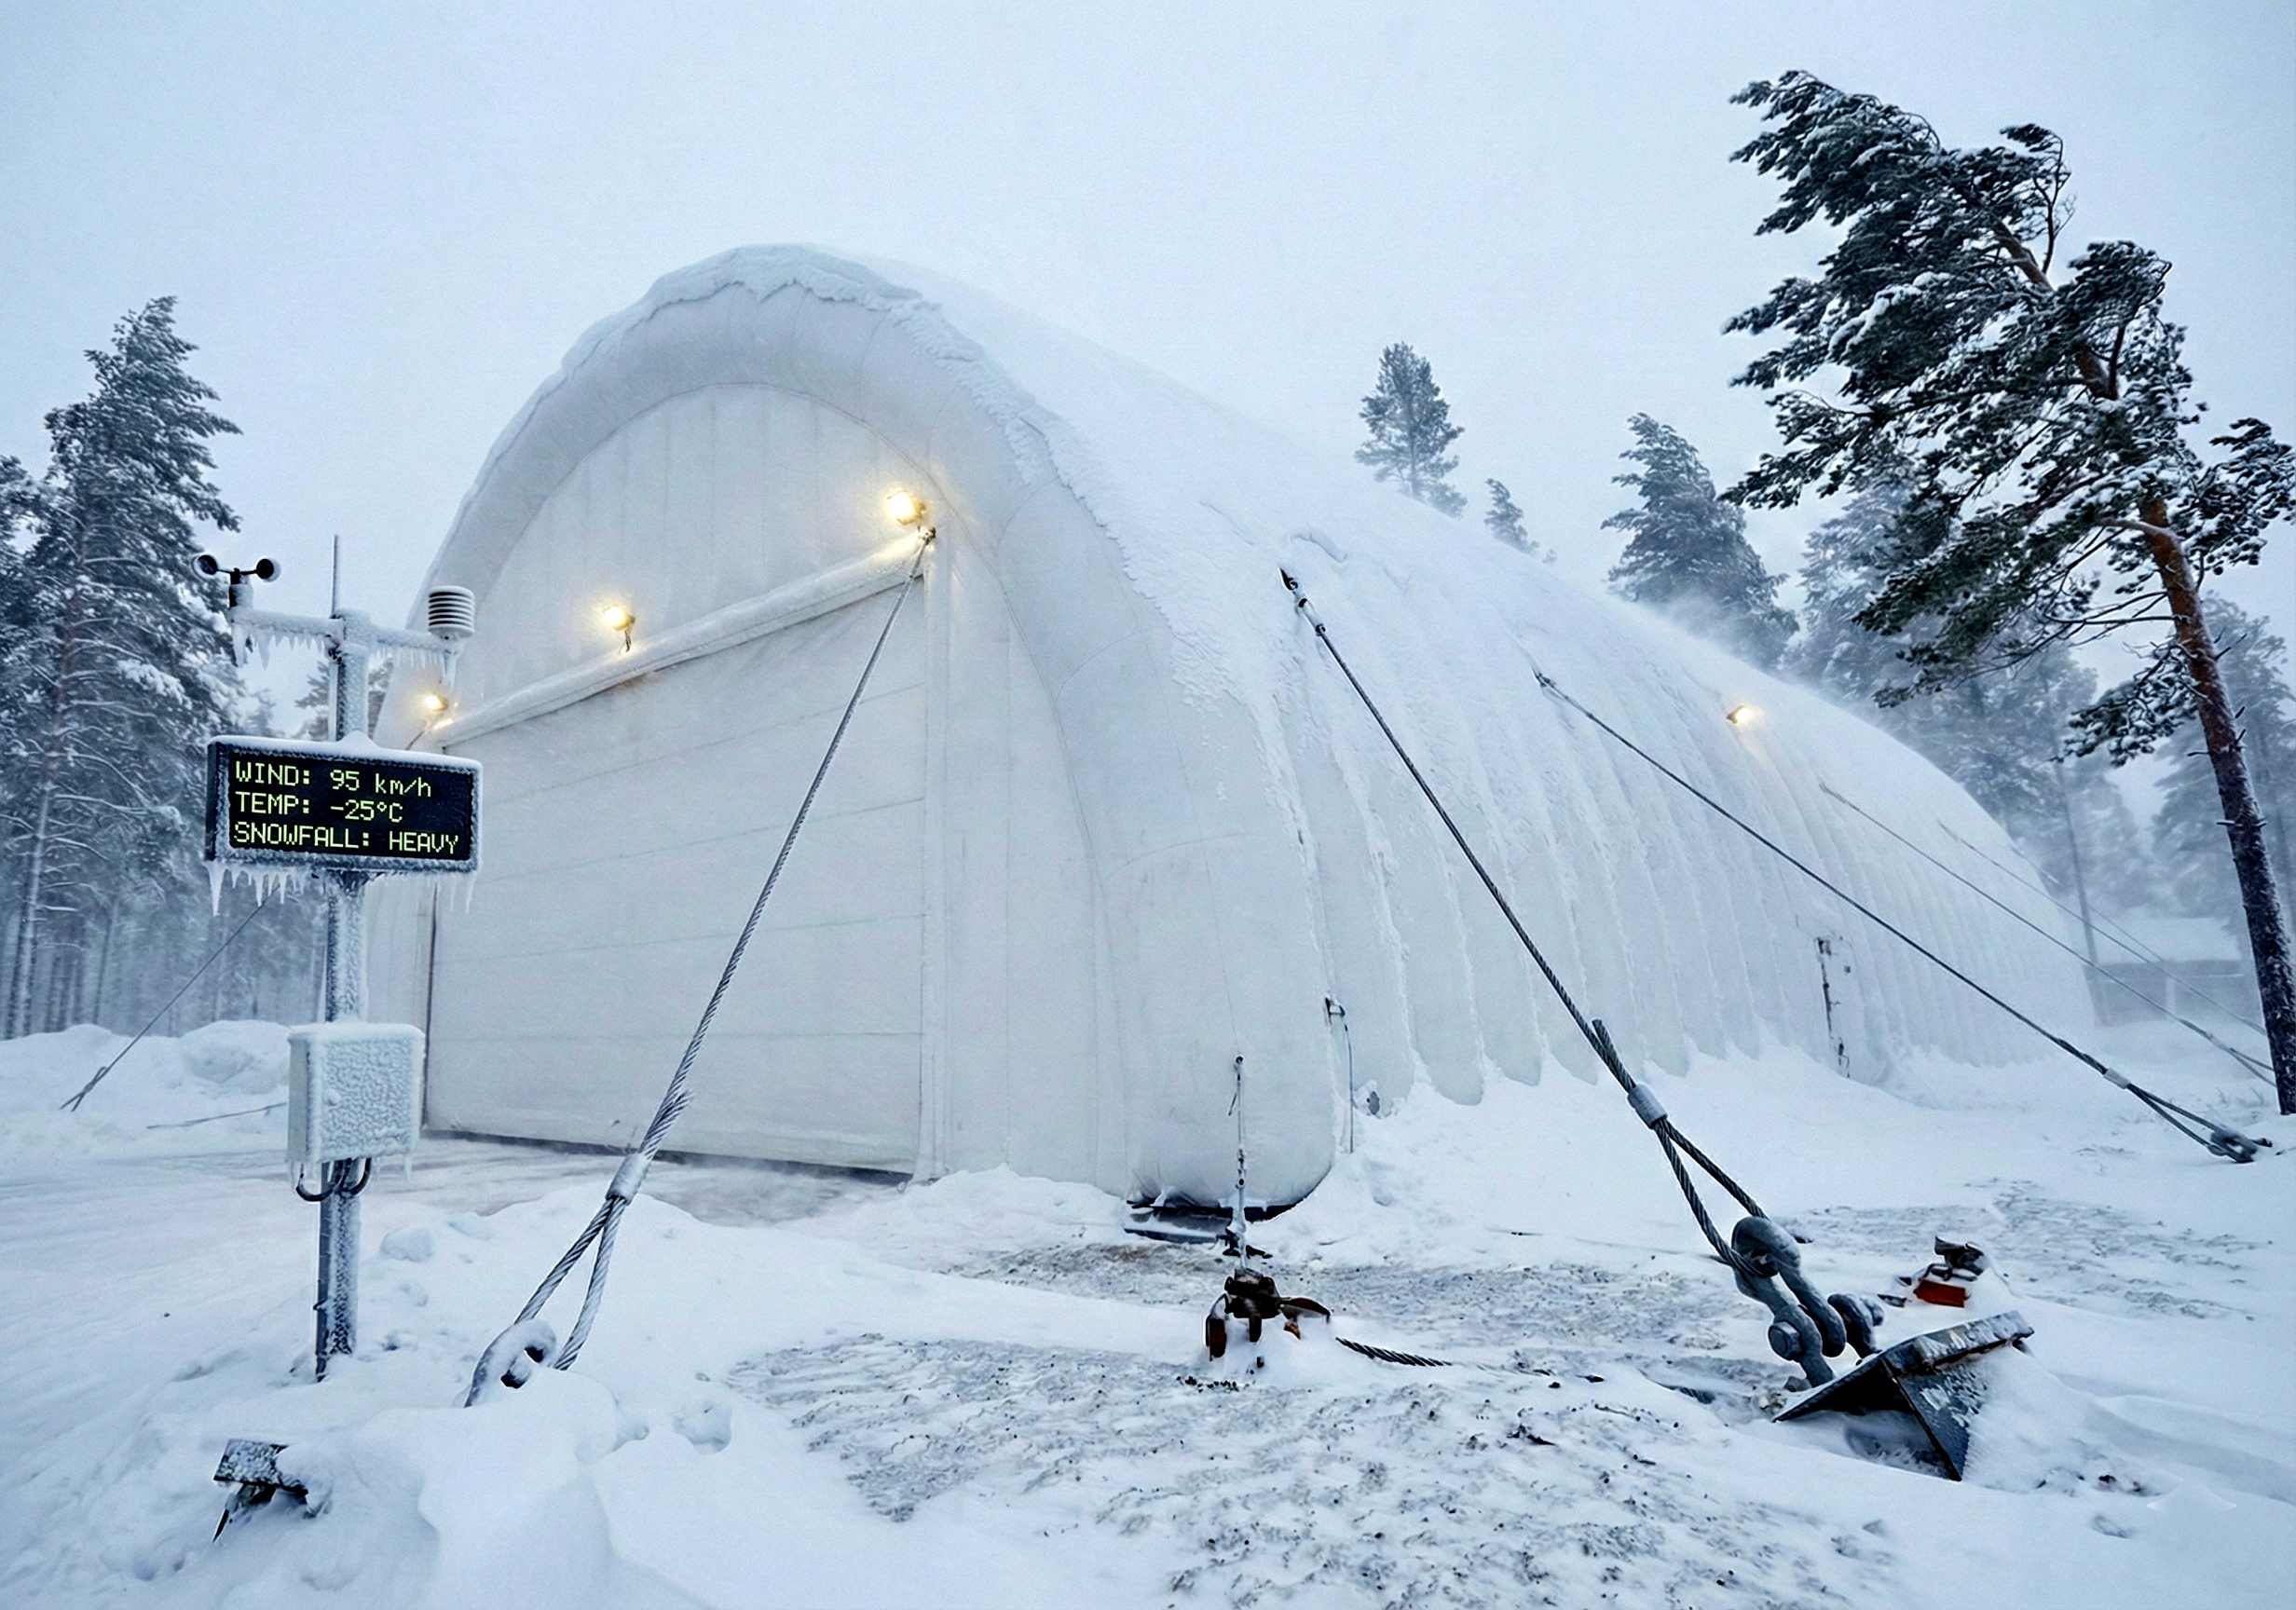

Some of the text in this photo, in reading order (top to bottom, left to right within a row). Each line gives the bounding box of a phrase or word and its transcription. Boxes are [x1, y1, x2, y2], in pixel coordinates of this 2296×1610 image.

[236, 760, 431, 798] WIND: 95 km/h
[235, 790, 403, 823] TEMP: -25°C
[233, 821, 459, 854] SNOWFALL: HEAVY
